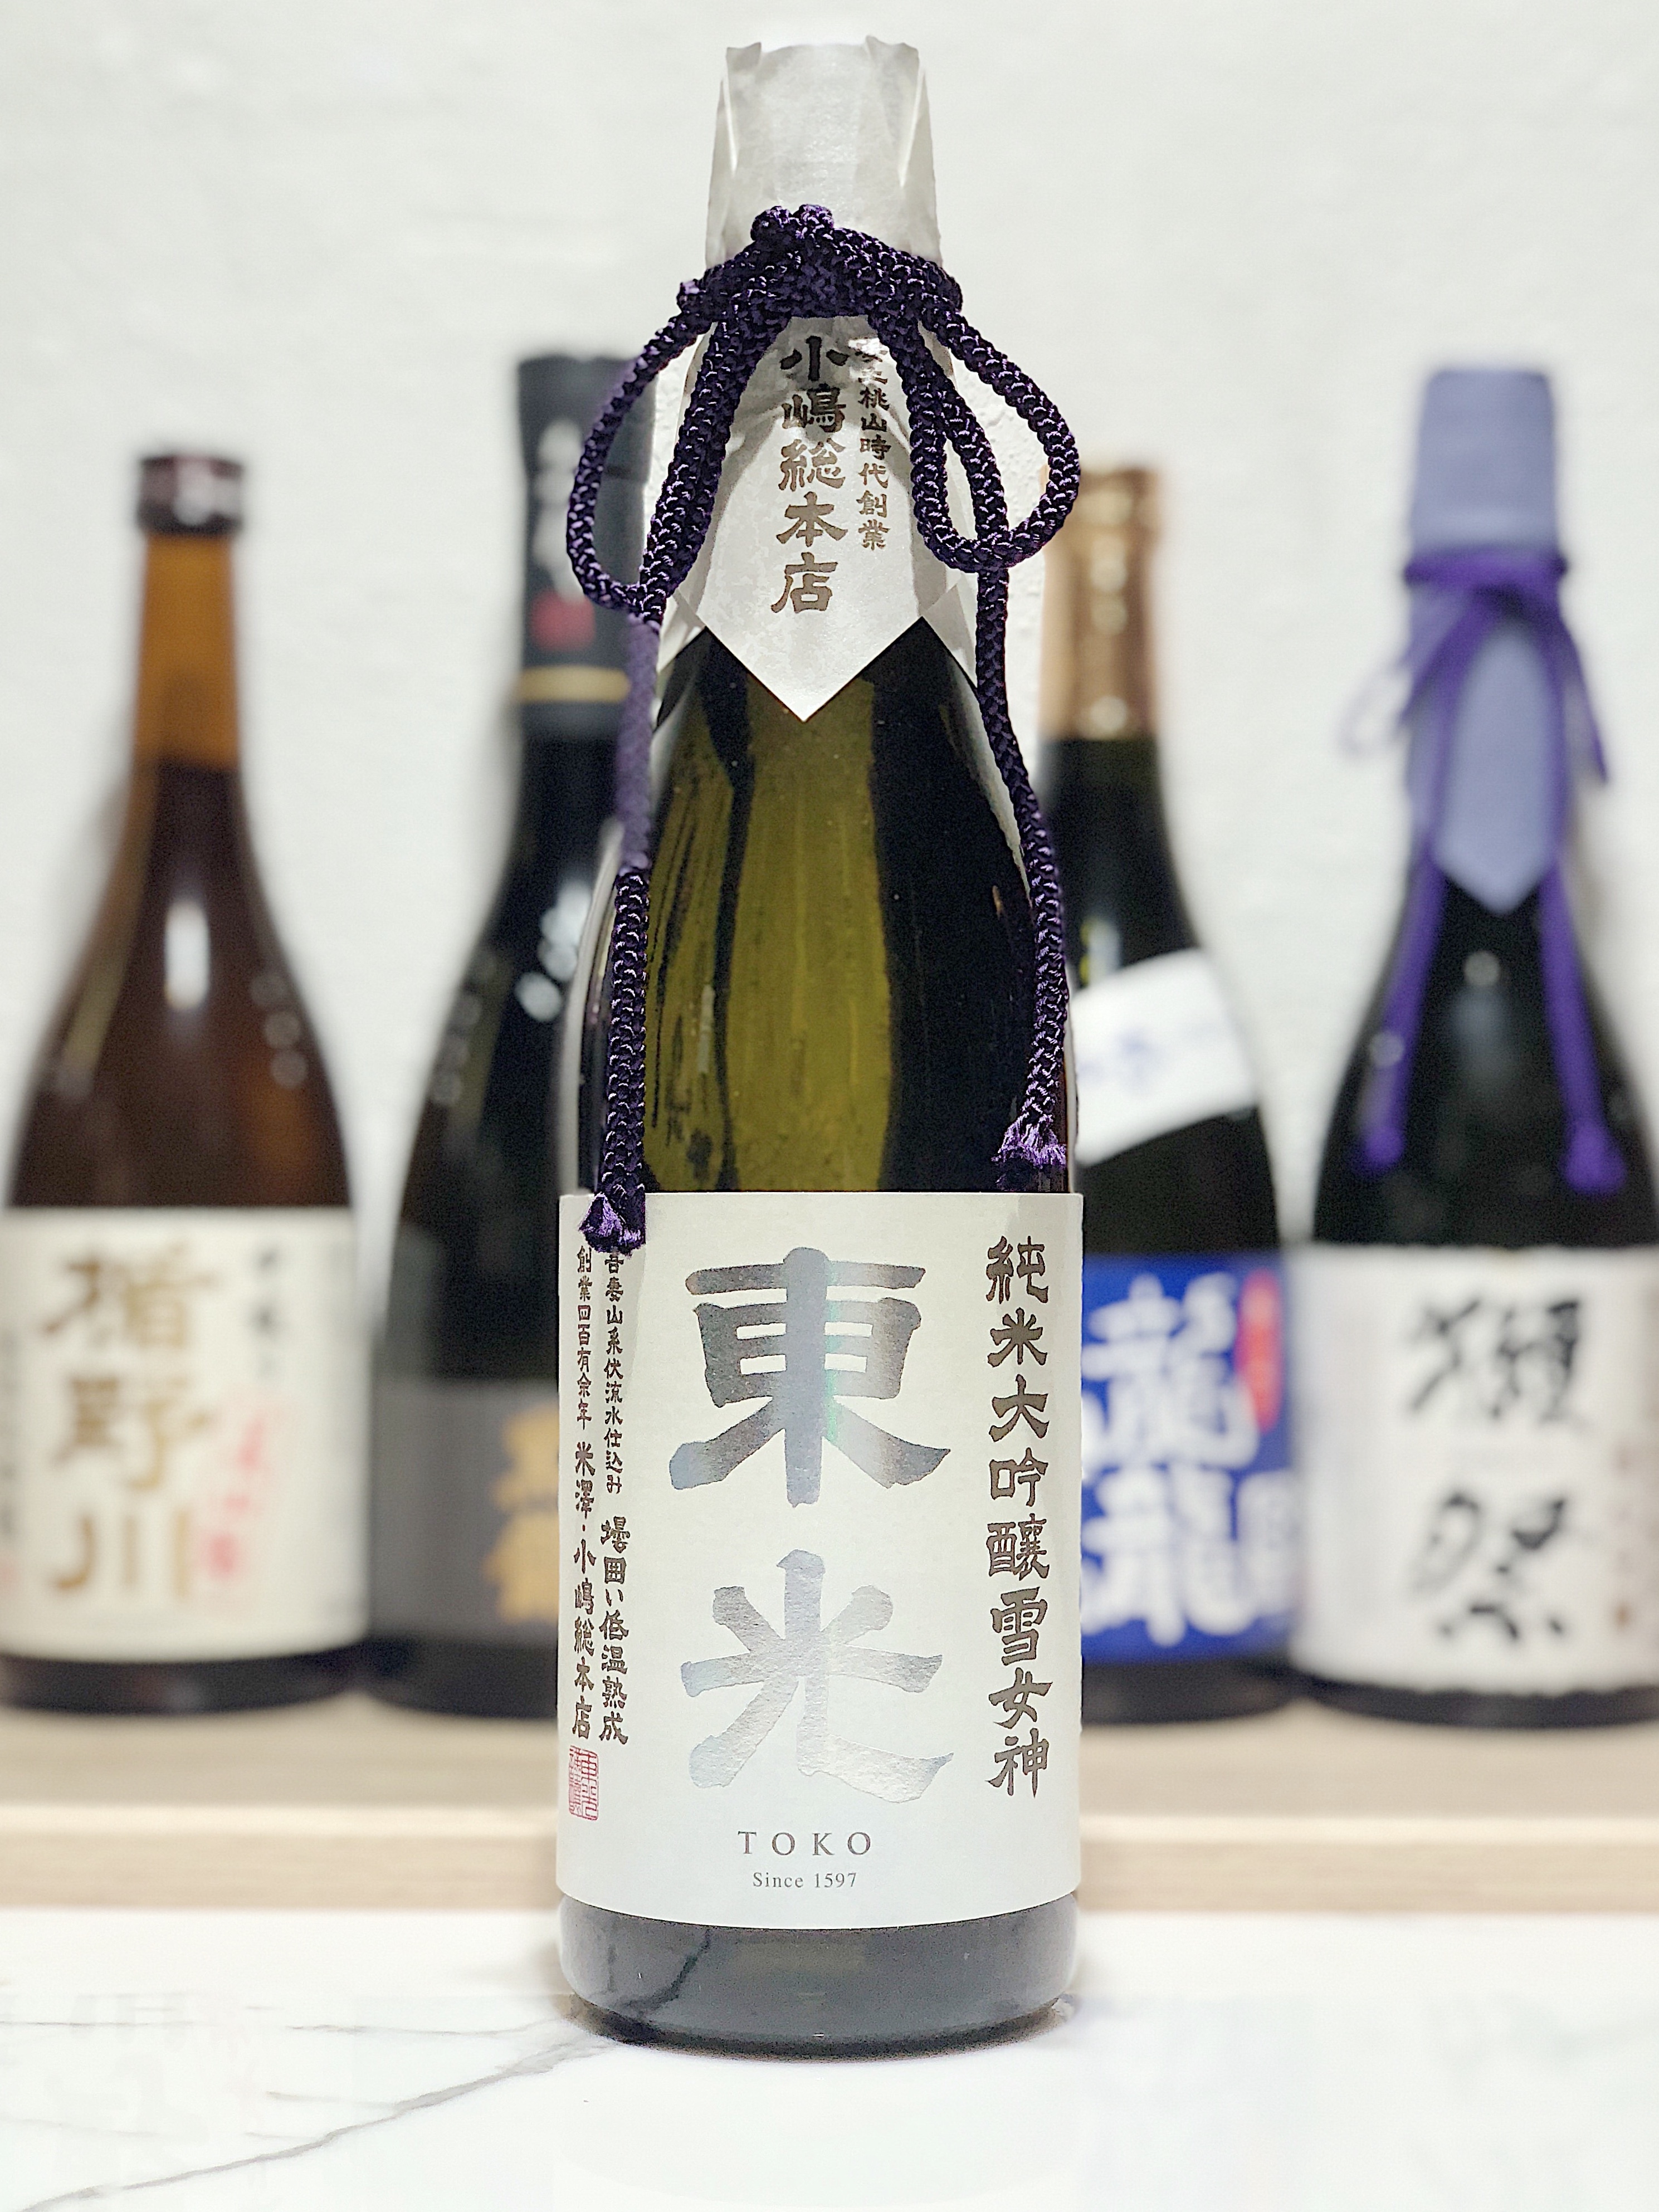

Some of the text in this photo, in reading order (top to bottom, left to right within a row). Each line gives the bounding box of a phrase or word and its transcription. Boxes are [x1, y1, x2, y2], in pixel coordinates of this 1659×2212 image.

[771, 335, 848, 613] 小嶋総本店
[669, 1247, 954, 1803] 東光
[737, 1830, 871, 1856] TOKO
[753, 1872, 857, 1888] Since 1597
